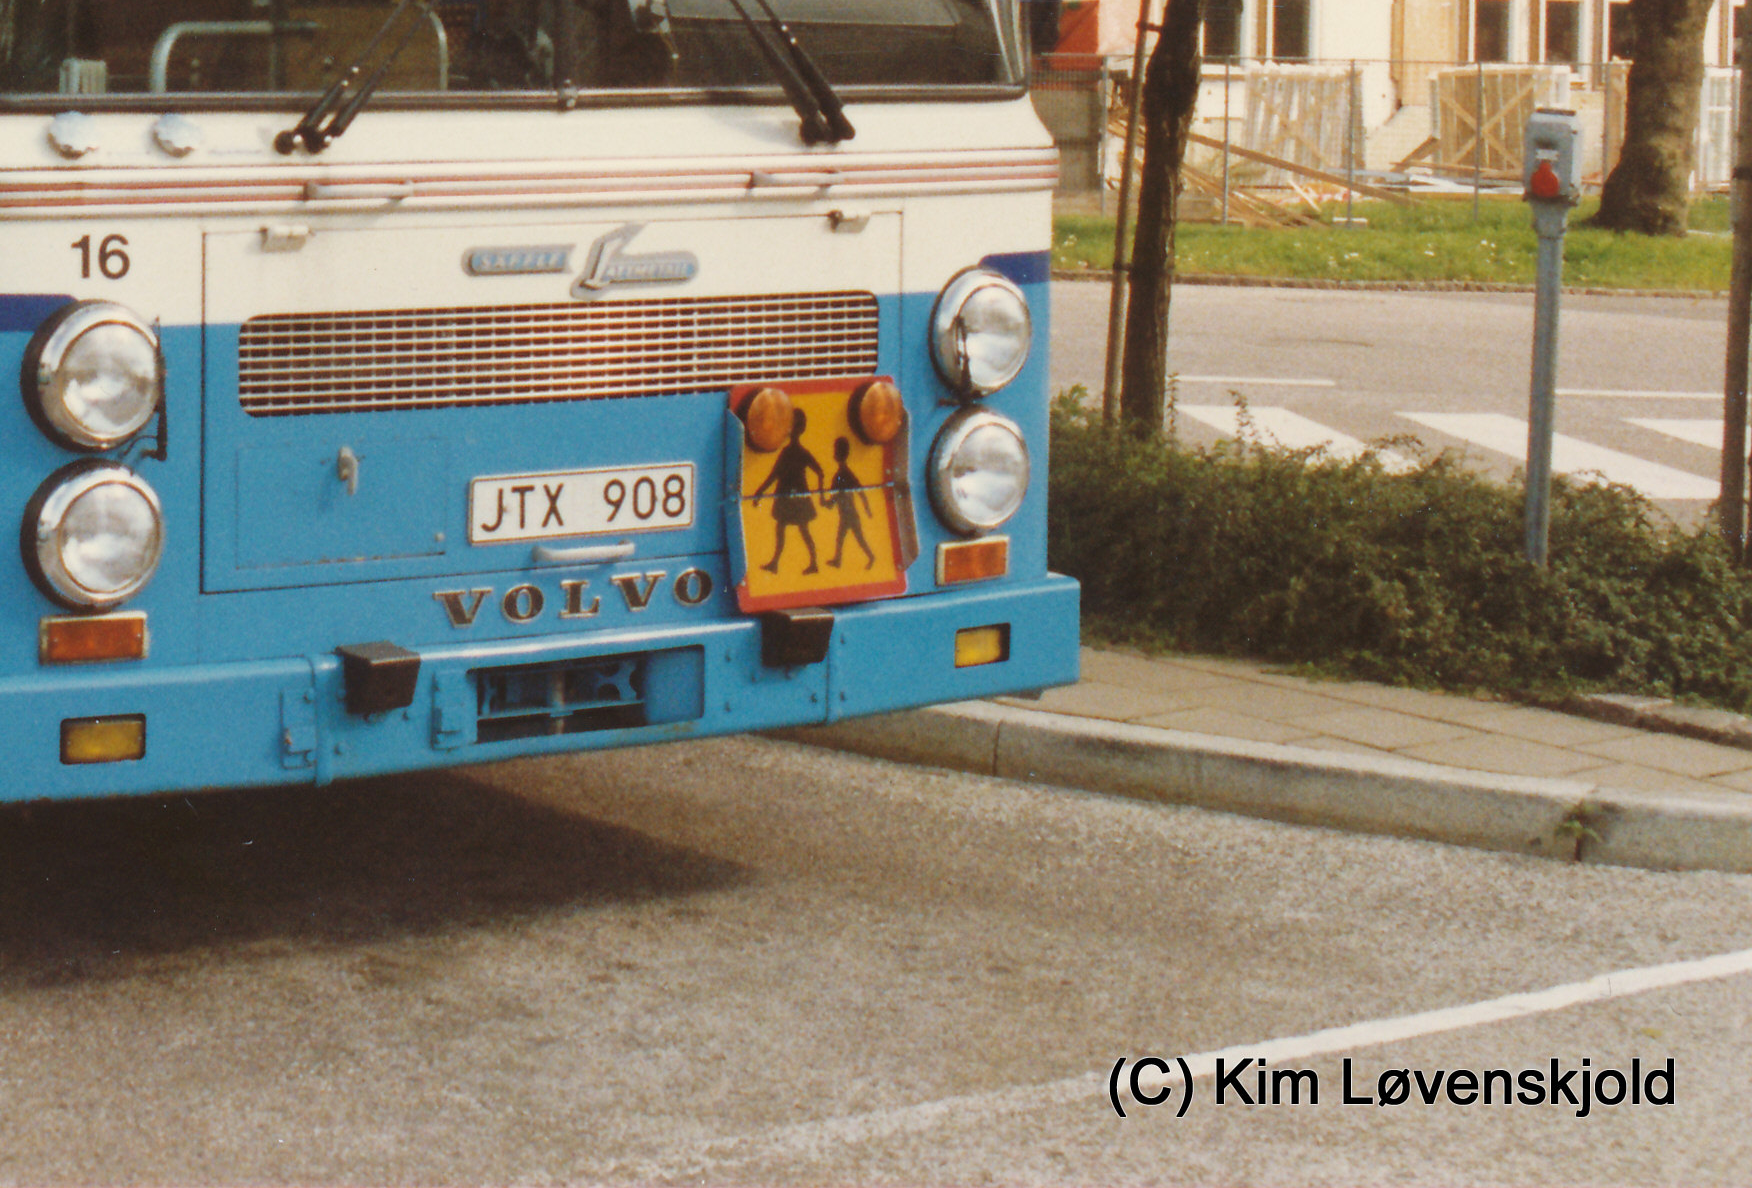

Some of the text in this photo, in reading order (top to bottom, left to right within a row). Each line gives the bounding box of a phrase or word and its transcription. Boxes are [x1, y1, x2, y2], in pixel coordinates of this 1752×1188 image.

[71, 233, 131, 281] 16
[481, 473, 686, 533] JTX 908
[434, 566, 714, 629] VOLVO
